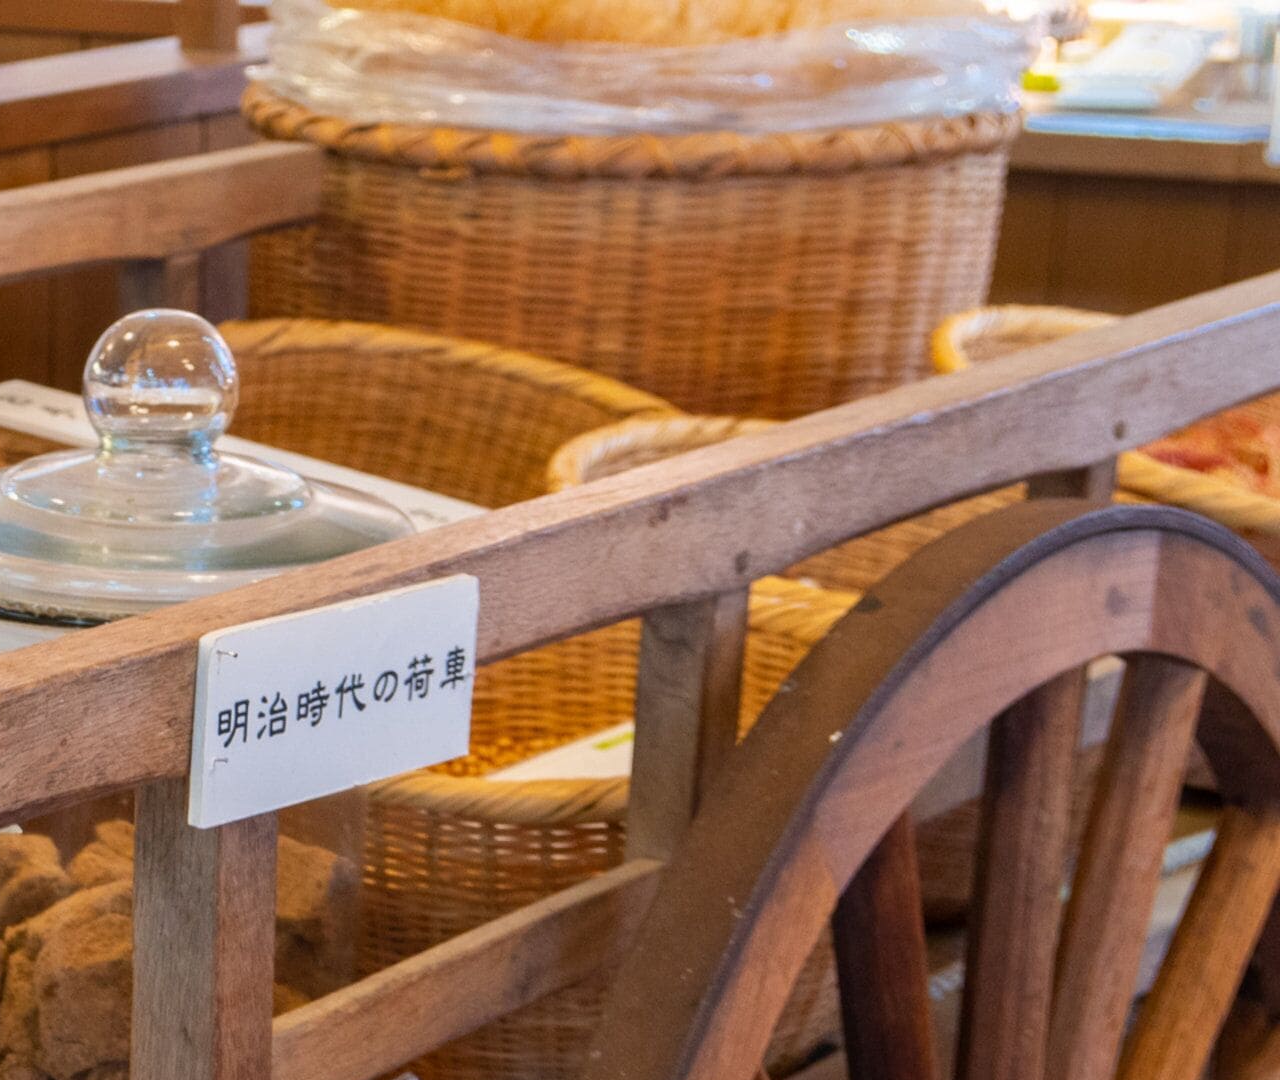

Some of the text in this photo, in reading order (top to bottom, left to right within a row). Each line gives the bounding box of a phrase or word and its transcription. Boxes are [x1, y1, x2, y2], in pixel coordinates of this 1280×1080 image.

[217, 646, 466, 748] 明治時代の荷車
